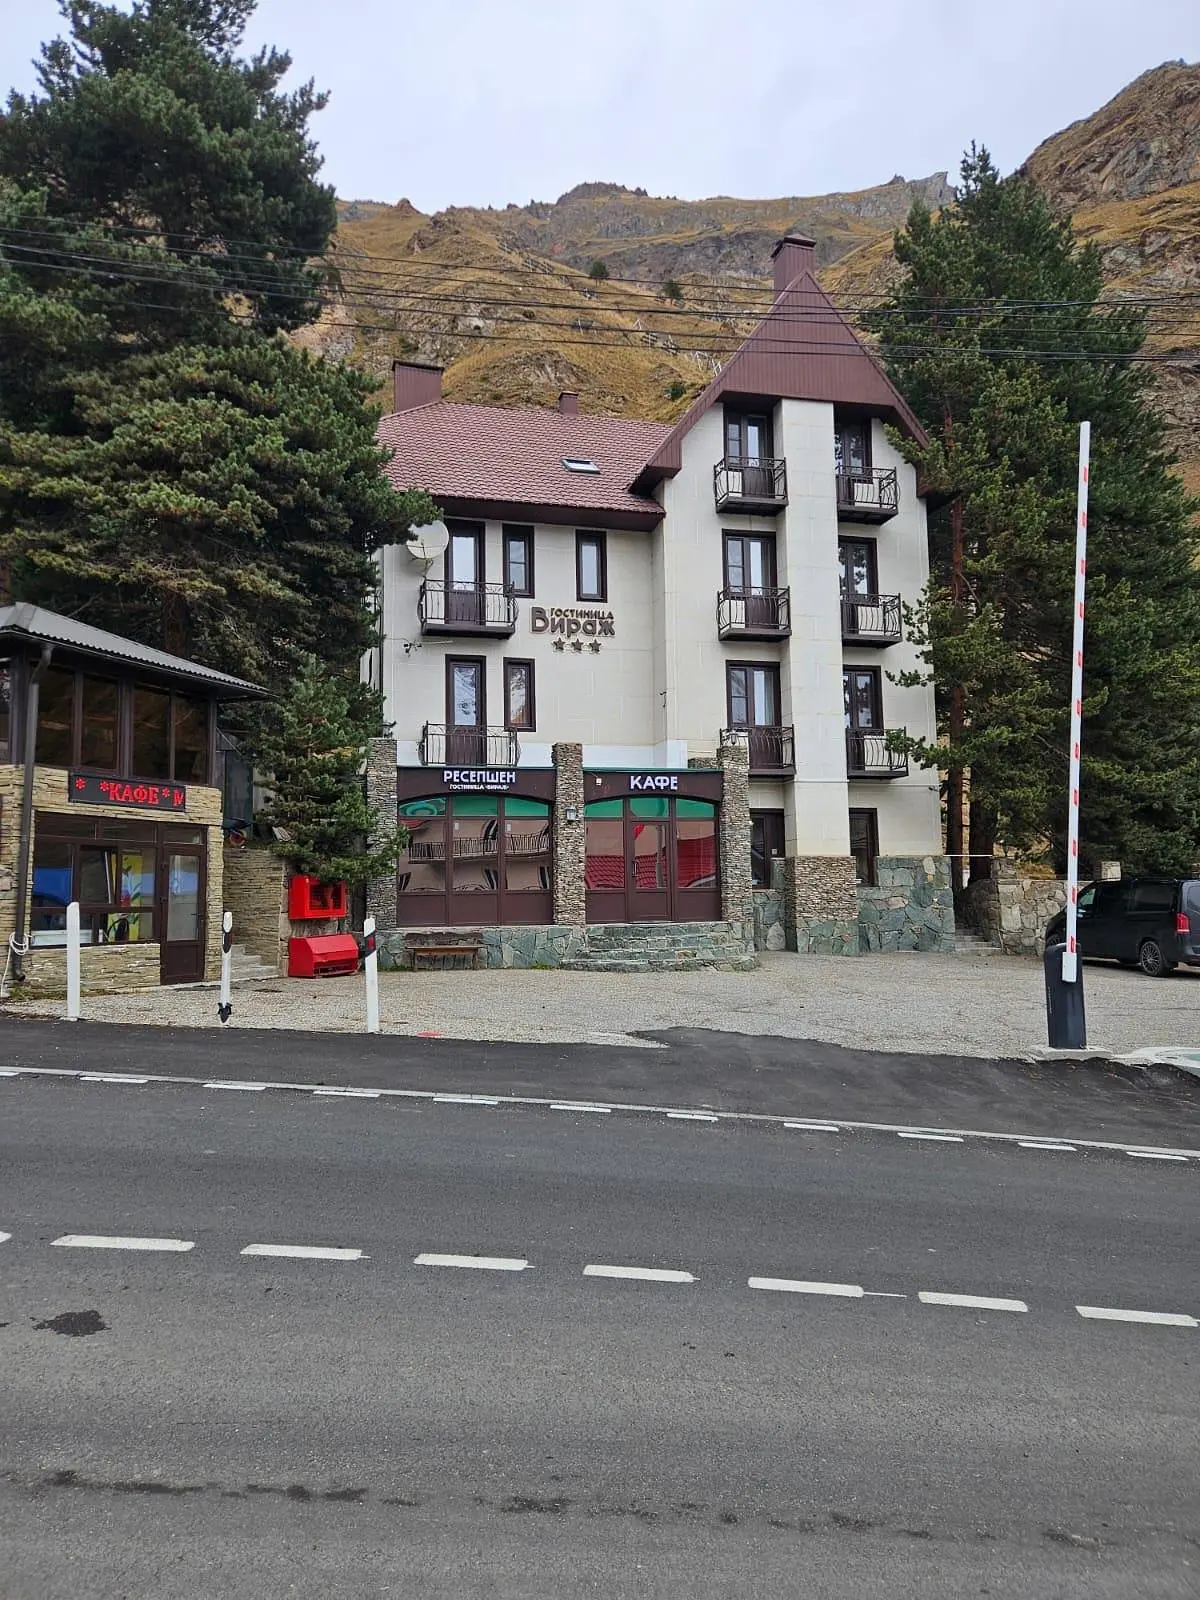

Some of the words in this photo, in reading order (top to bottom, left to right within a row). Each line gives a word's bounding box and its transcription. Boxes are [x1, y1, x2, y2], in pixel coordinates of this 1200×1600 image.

[550, 607, 614, 620] ГОСТИНИЦА
[531, 606, 616, 638] Вираж
[443, 770, 516, 783] РЕСЕПШЕН
[630, 775, 678, 790] КАФЕ
